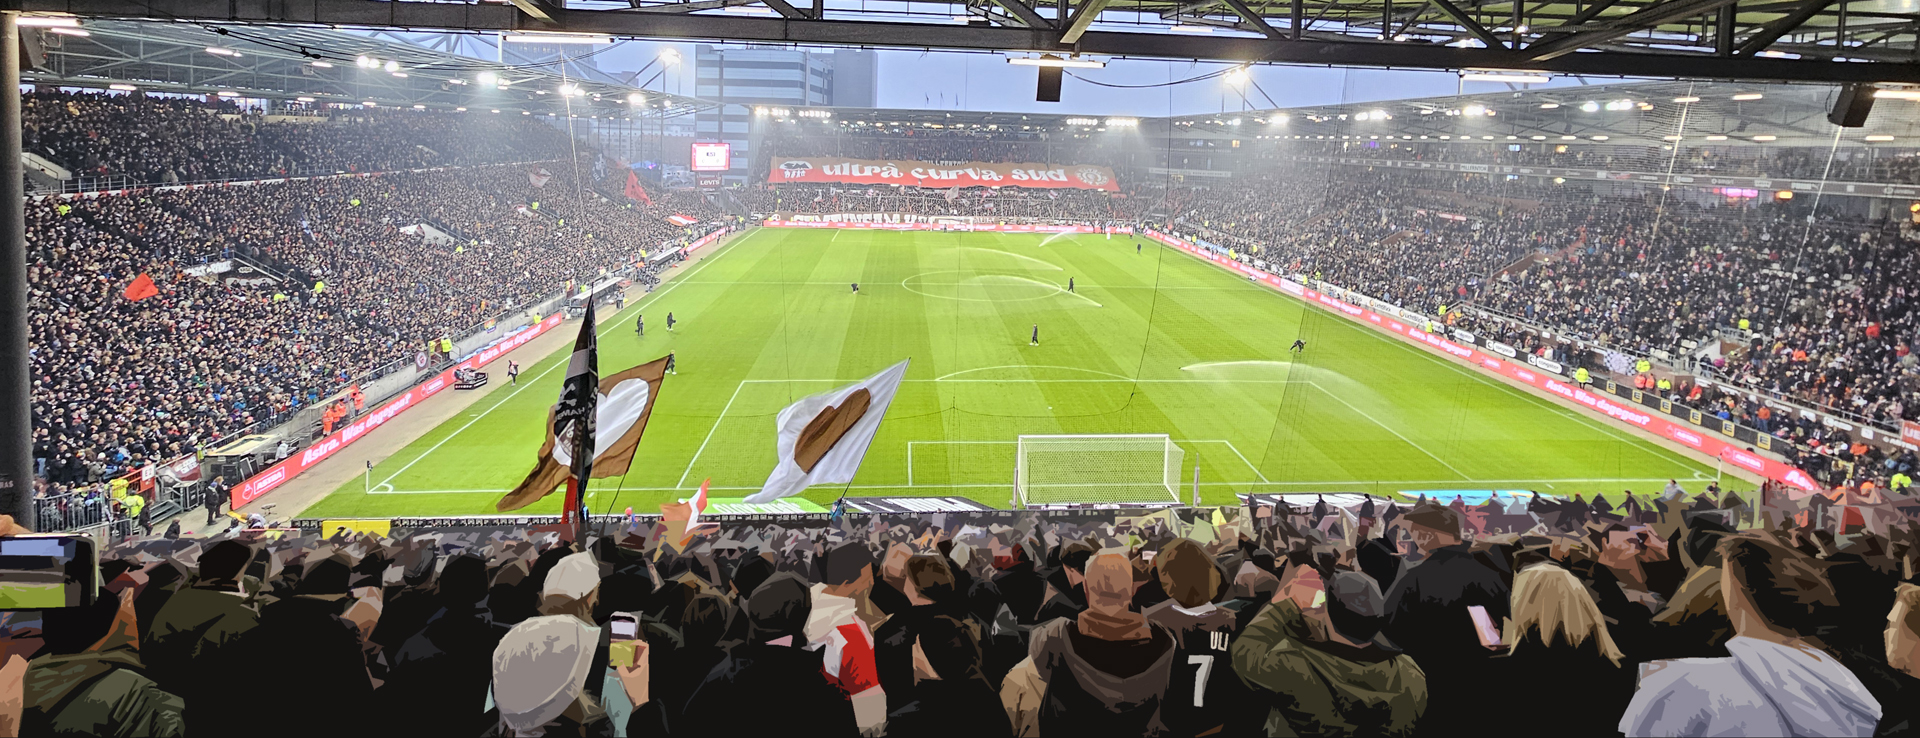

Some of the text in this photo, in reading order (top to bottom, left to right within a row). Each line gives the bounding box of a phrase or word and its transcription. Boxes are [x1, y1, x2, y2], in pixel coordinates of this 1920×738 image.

[822, 162, 904, 178] ultrà
[911, 167, 1003, 181] curva
[1012, 169, 1068, 182] sud
[1546, 379, 1650, 425] Astra. Was dagegen?
[301, 392, 412, 466] Astra. Was dagegen?
[1676, 430, 1700, 444] ASTRA
[1734, 452, 1763, 469] ASTRA
[256, 471, 283, 490] ASTRA
[1188, 655, 1215, 708] 7
